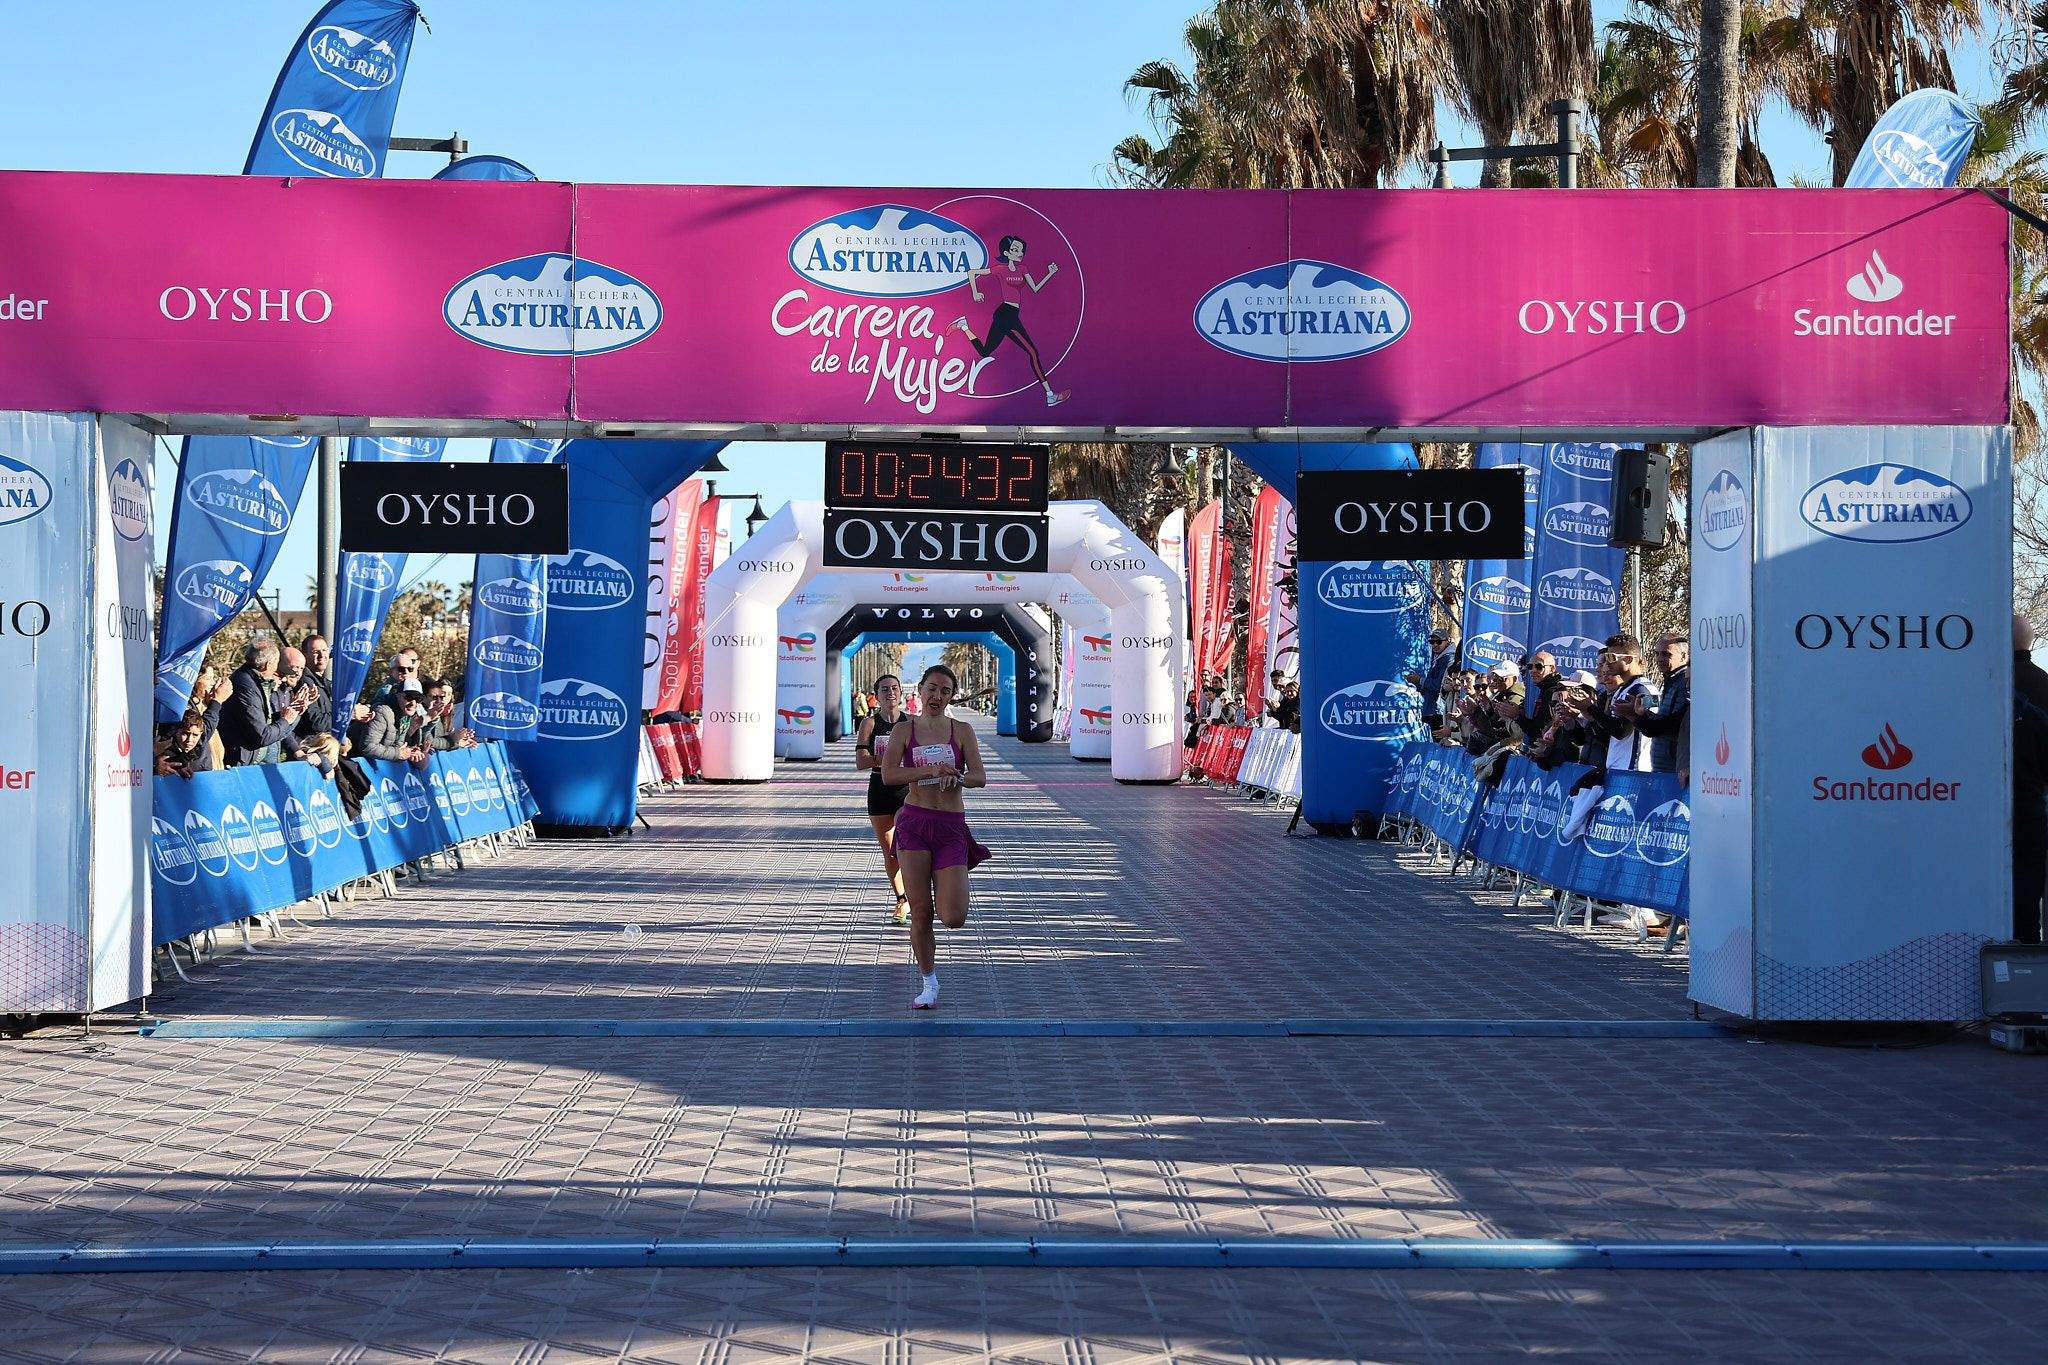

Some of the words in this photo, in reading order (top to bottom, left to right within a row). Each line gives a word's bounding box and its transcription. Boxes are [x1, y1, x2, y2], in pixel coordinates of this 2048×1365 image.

[279, 117, 366, 176] ASTURIANA
[835, 236, 896, 246] CENTRAL
[904, 237, 966, 247] LECHERA
[804, 237, 971, 274] ASTURIANA
[159, 285, 334, 324] OYSHO
[494, 288, 563, 299] CENTRAL
[569, 290, 638, 300] LECHERA
[1244, 295, 1312, 306] CENTRAL
[1318, 295, 1387, 305] LECHERA
[460, 289, 646, 330] ASTURIANA
[770, 289, 936, 339] Carrera
[1211, 298, 1394, 336] ASTURIANA
[1518, 299, 1688, 335] OYSHO
[1793, 308, 1957, 337] Santander
[810, 341, 842, 374] de
[847, 339, 870, 374] la
[864, 334, 996, 414] Mujer
[841, 451, 1033, 502] 00:24:32
[196, 481, 283, 530] ASTURINA
[1812, 492, 1960, 523] ASTURIANA
[1839, 491, 1894, 499] CENTRAL
[1898, 491, 1955, 499] LECHERA
[376, 492, 536, 526] OYSHO
[1334, 500, 1492, 534] OYSHO
[835, 518, 1038, 564] OYSHO
[669, 509, 692, 609] Santander
[738, 560, 794, 573] OYSHO
[1090, 559, 1146, 571] OYSHO
[549, 569, 583, 577] ENTRAL
[586, 570, 626, 580] LECHERA
[544, 577, 628, 598] TURIANA
[883, 585, 929, 593] TotalEnergies
[1541, 580, 1616, 605] ASTURIANA
[107, 602, 148, 643] OYSHO
[872, 608, 984, 619] VOLVO
[711, 634, 764, 648] OYSHO
[1121, 636, 1174, 649] OYSHO
[1698, 613, 1746, 651] OYSHO
[1794, 614, 1974, 650] OYSHO
[478, 645, 539, 666] ASTURIANA
[661, 638, 679, 700] Sports
[474, 703, 535, 723] ASTURIANA
[542, 698, 576, 706] ENTRAL
[579, 699, 619, 708] LECHERA
[536, 708, 621, 727] STURIANA
[709, 710, 761, 724] OYSHO
[1121, 712, 1174, 725] OYSHO
[106, 764, 144, 788] Santander
[1701, 771, 1743, 797] Santander
[1813, 776, 1962, 801] Santander
